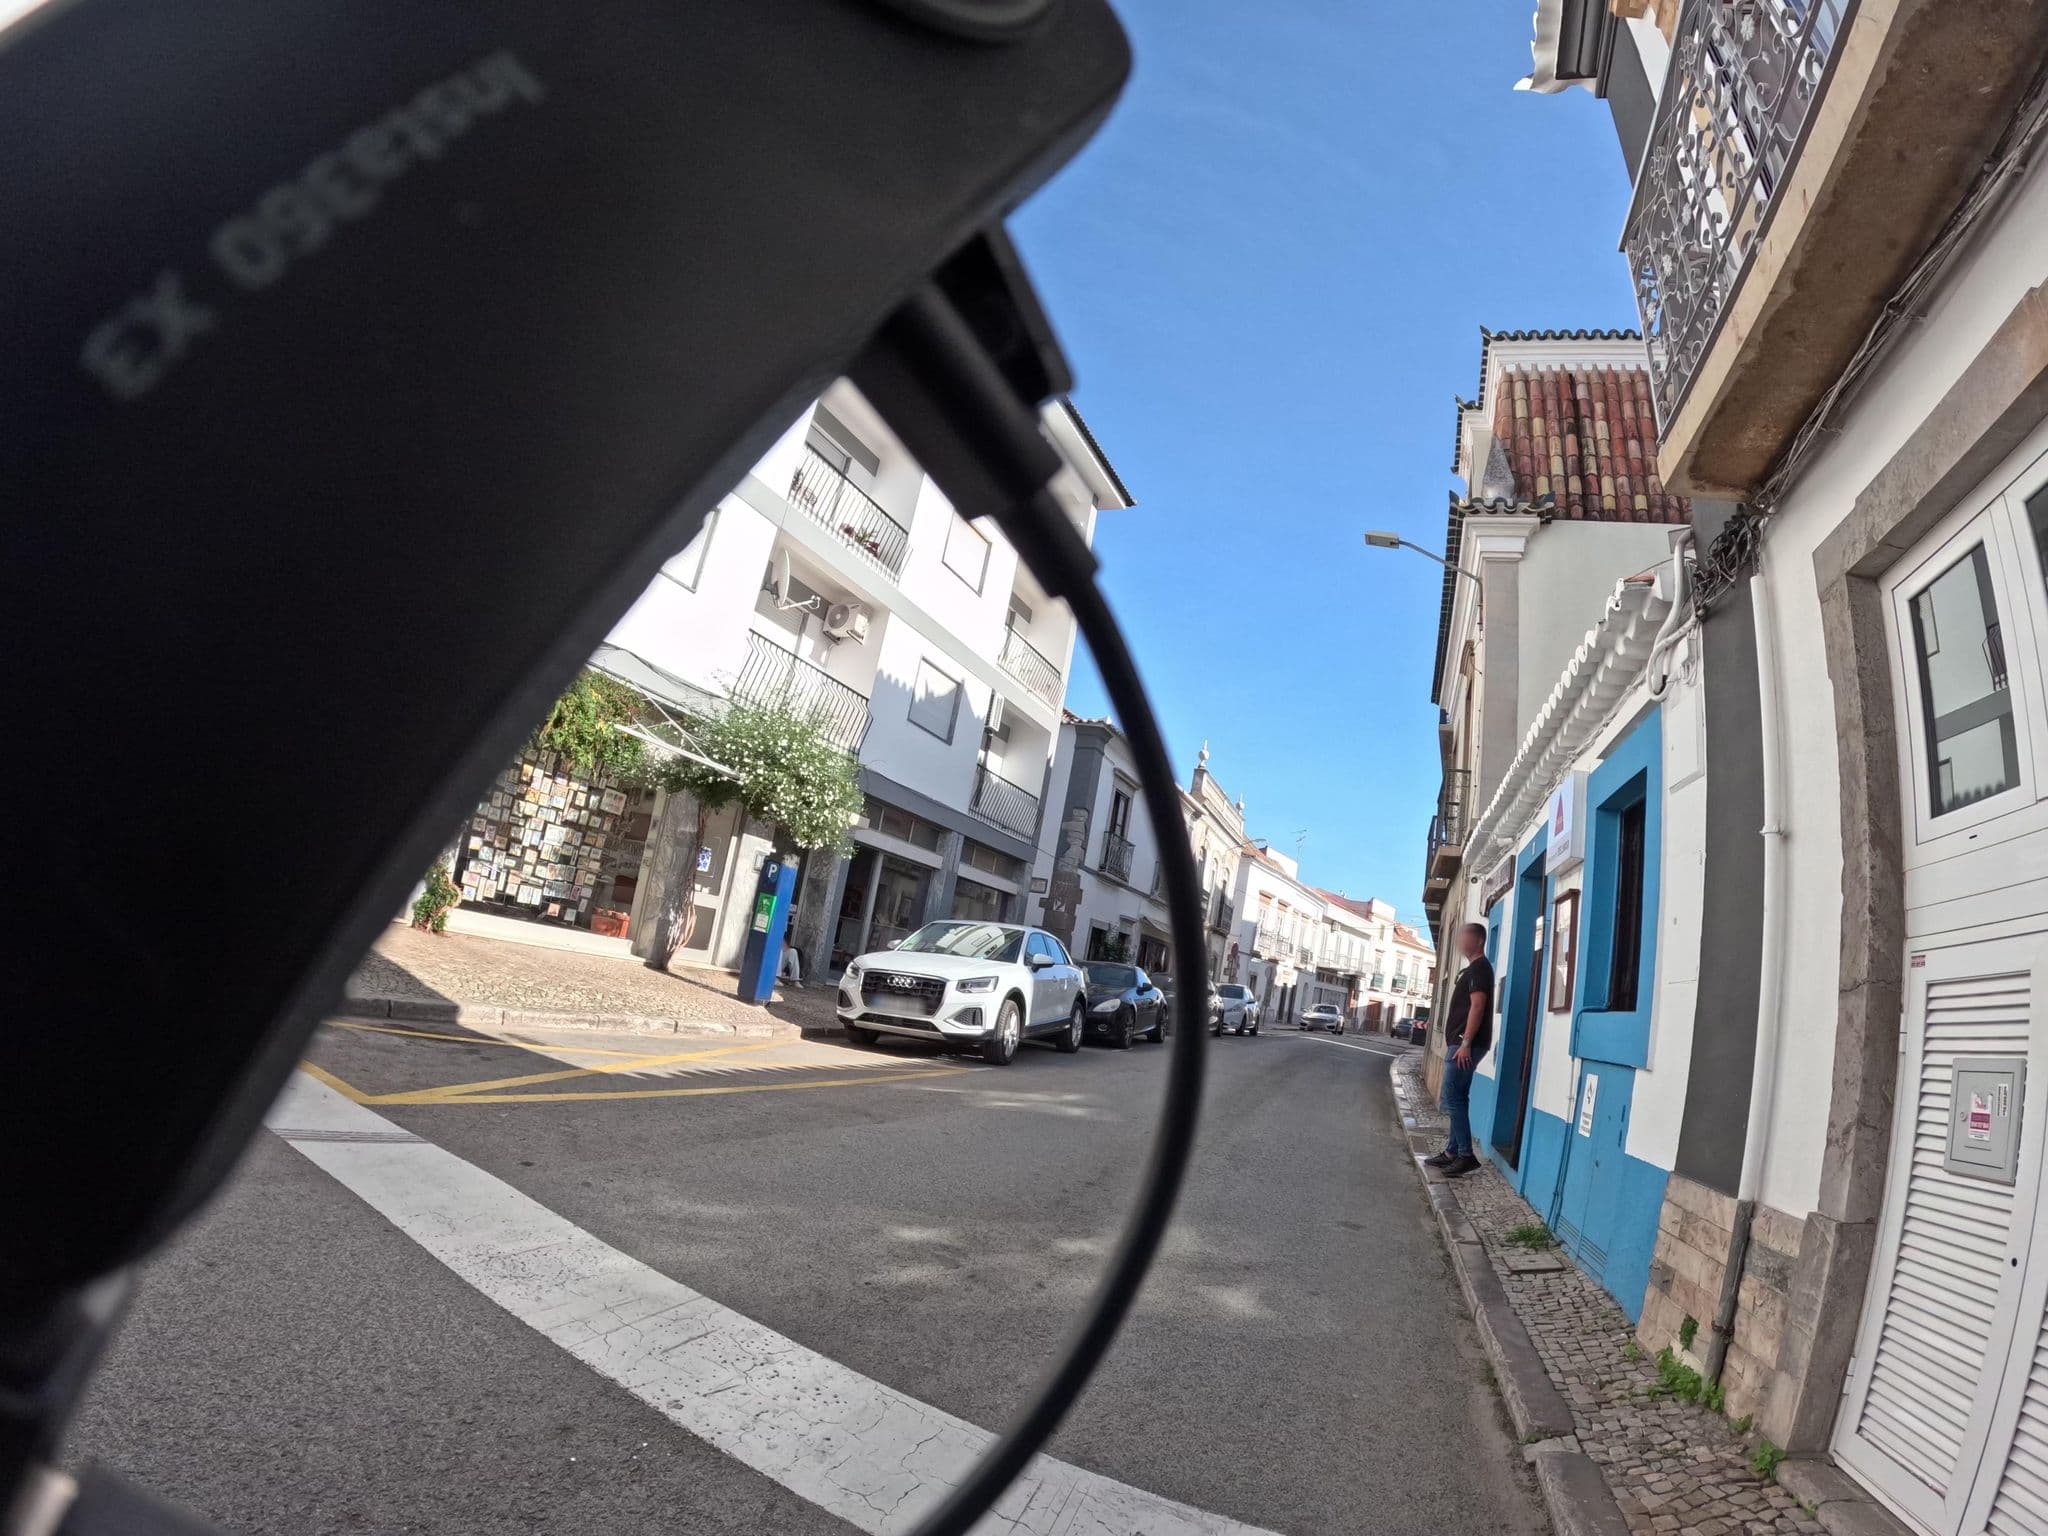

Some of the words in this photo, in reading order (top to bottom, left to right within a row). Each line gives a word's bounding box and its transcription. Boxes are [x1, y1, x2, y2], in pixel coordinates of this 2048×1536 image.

[210, 50, 544, 288] Insta360
[82, 267, 219, 396] X3
[768, 864, 778, 878] P
